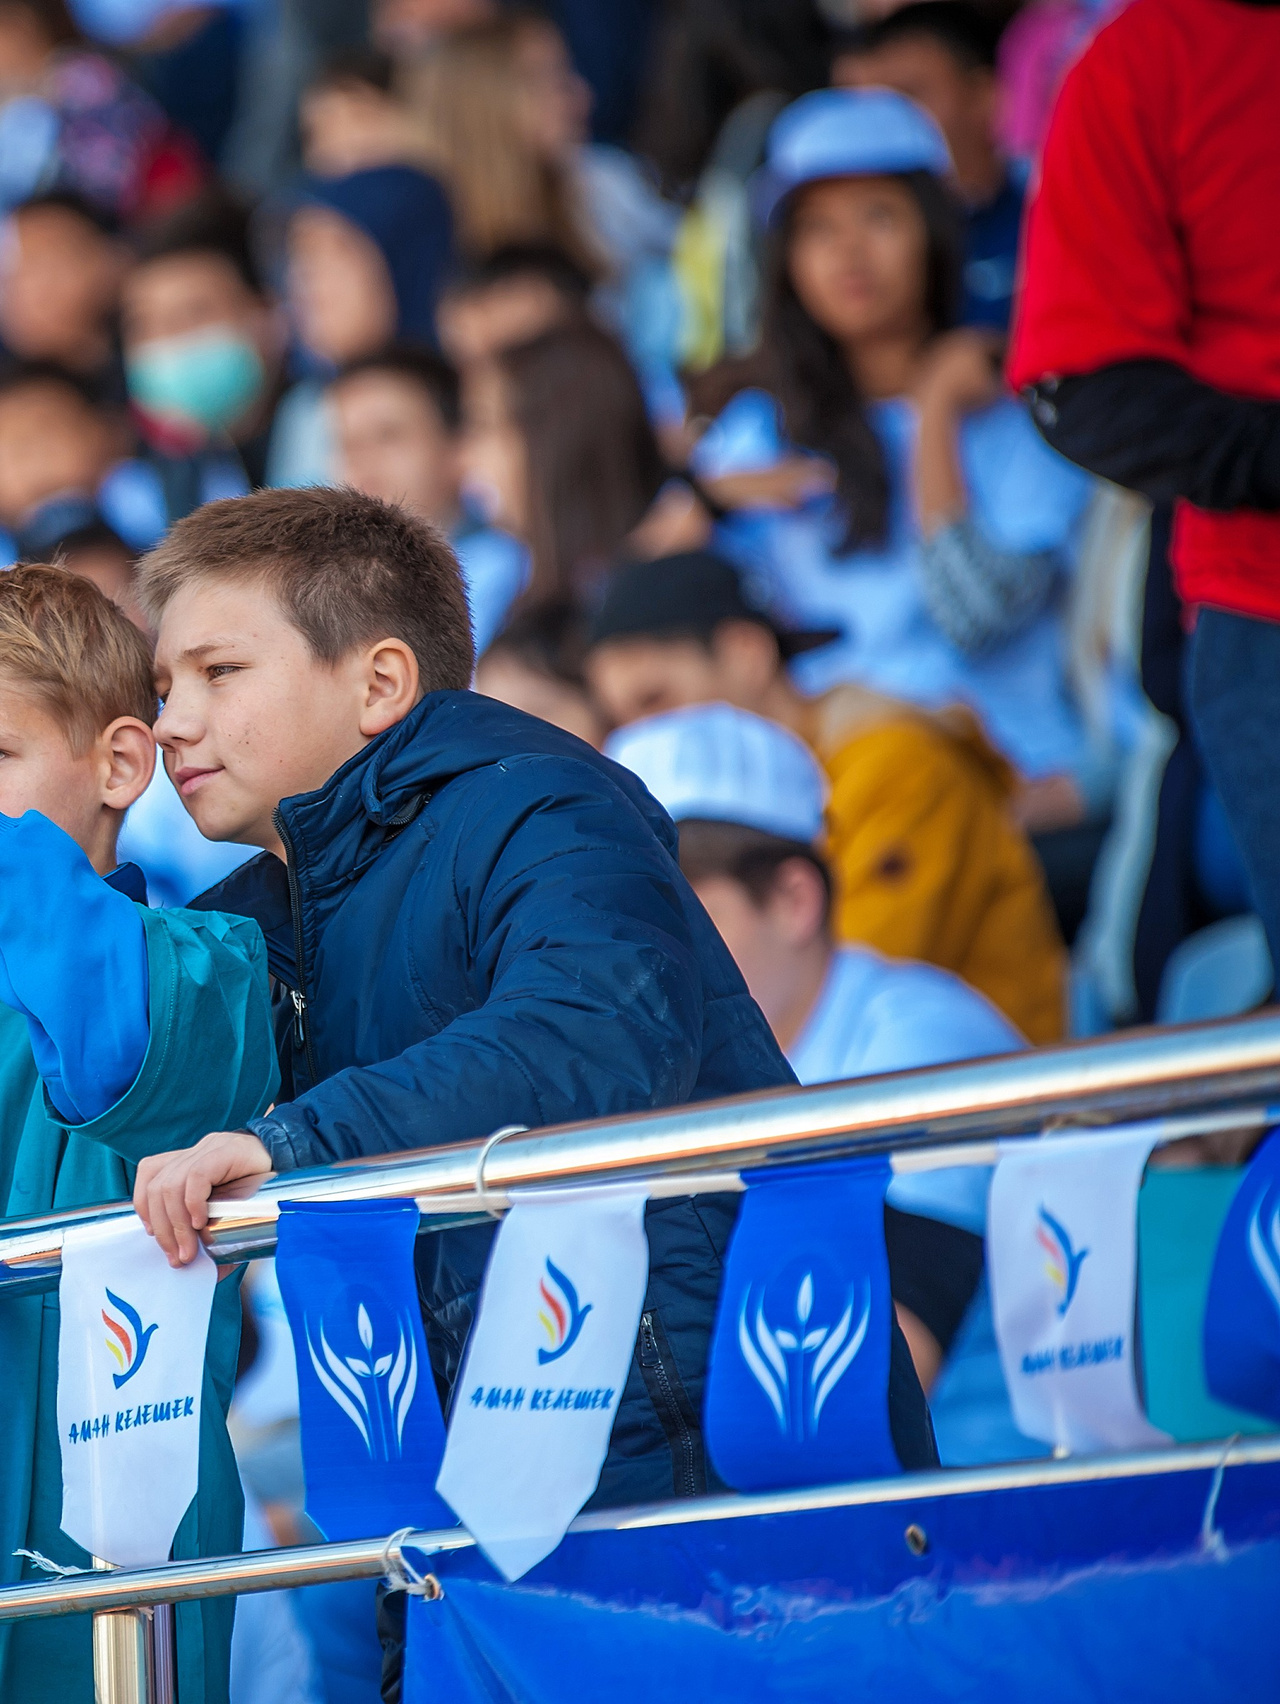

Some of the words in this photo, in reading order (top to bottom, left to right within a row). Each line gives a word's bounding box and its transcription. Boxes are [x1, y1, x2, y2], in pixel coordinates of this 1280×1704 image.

[471, 1386, 526, 1412] АМАН
[530, 1387, 615, 1412] КЕЛЕШЕК
[68, 1413, 110, 1444] АМАН
[115, 1396, 194, 1433] КЕЛЕШЕК
